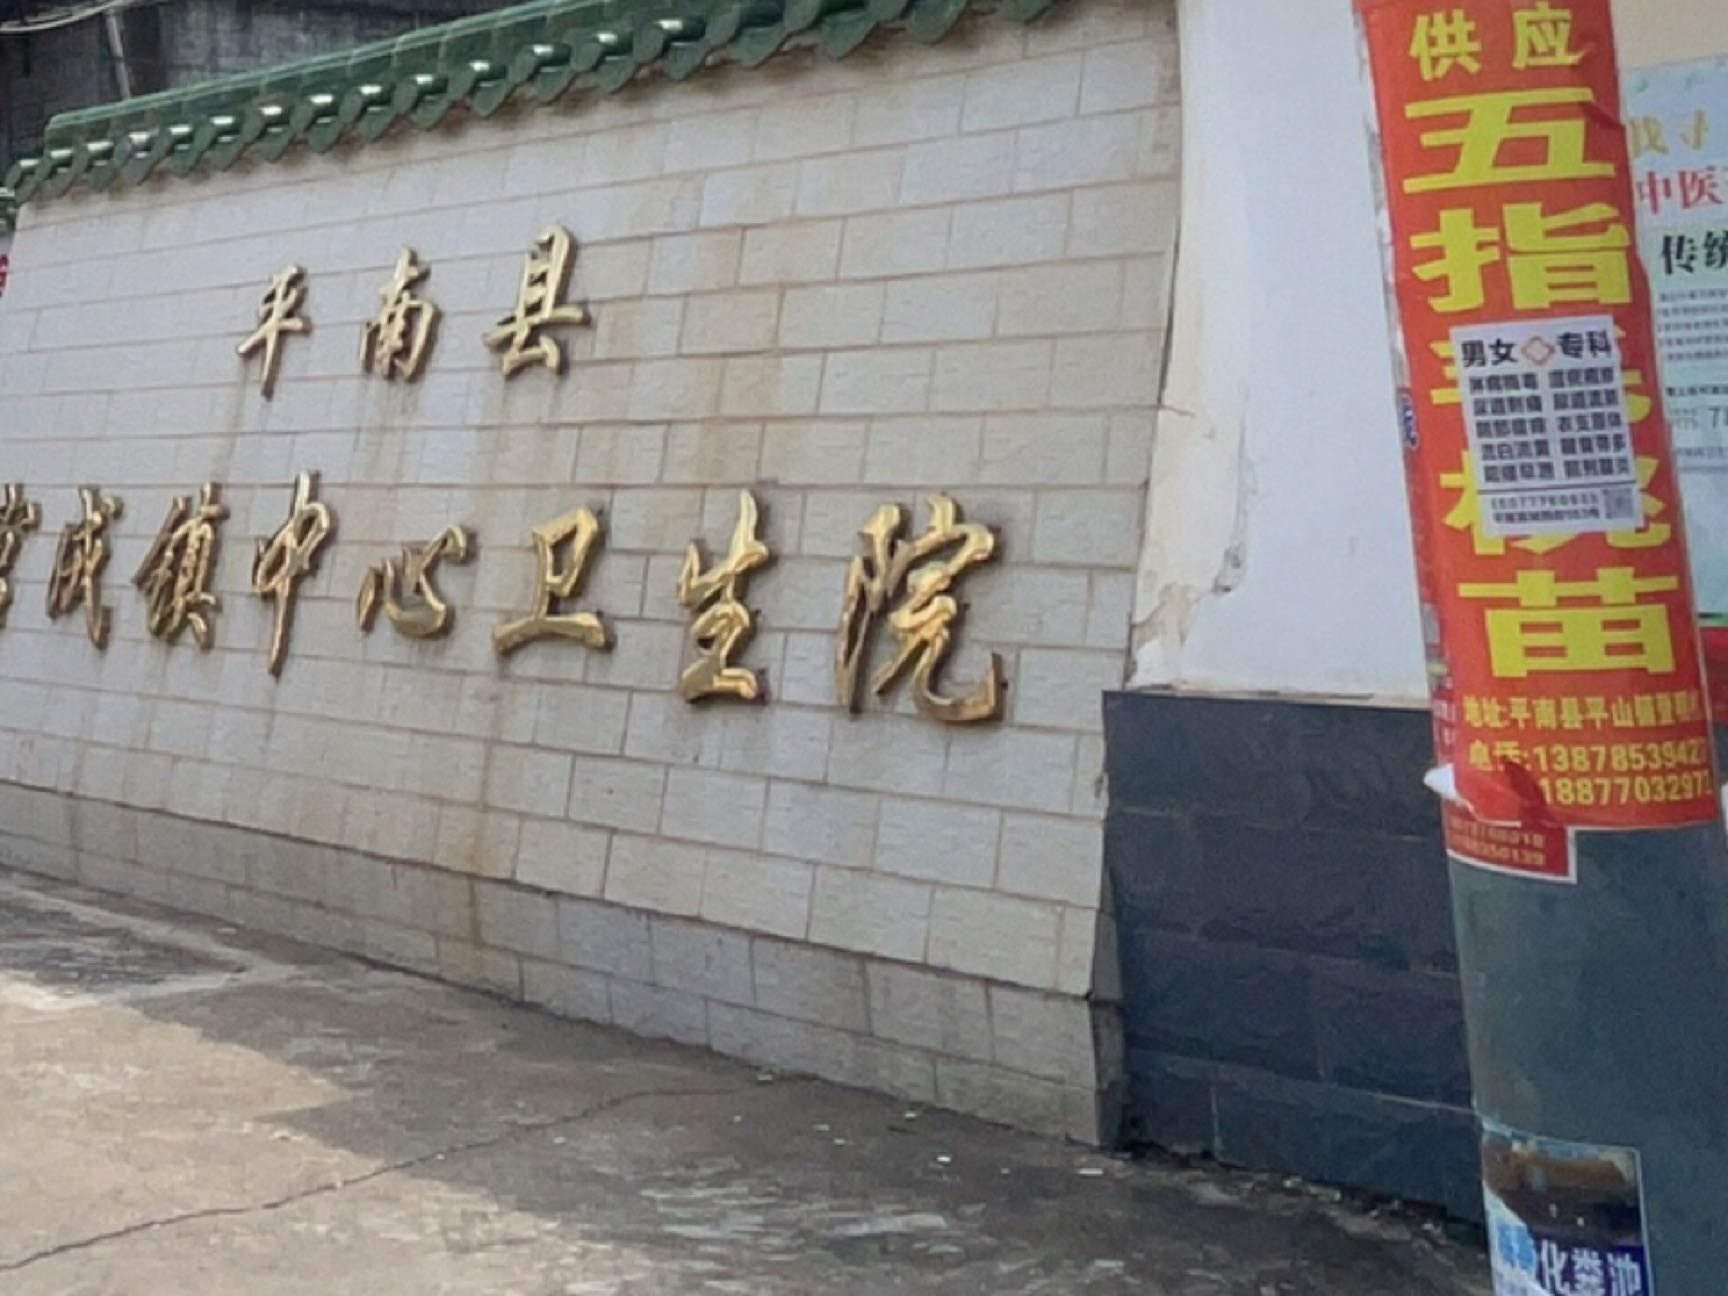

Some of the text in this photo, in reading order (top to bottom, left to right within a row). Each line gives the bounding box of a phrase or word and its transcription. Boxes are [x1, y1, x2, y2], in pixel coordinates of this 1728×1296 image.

[1410, 0, 1590, 81] 供应
[1636, 165, 1728, 215] 中医
[236, 224, 592, 402] 平南县
[1461, 329, 1612, 367] 男女 专科
[1402, 87, 1679, 678] 五指苗
